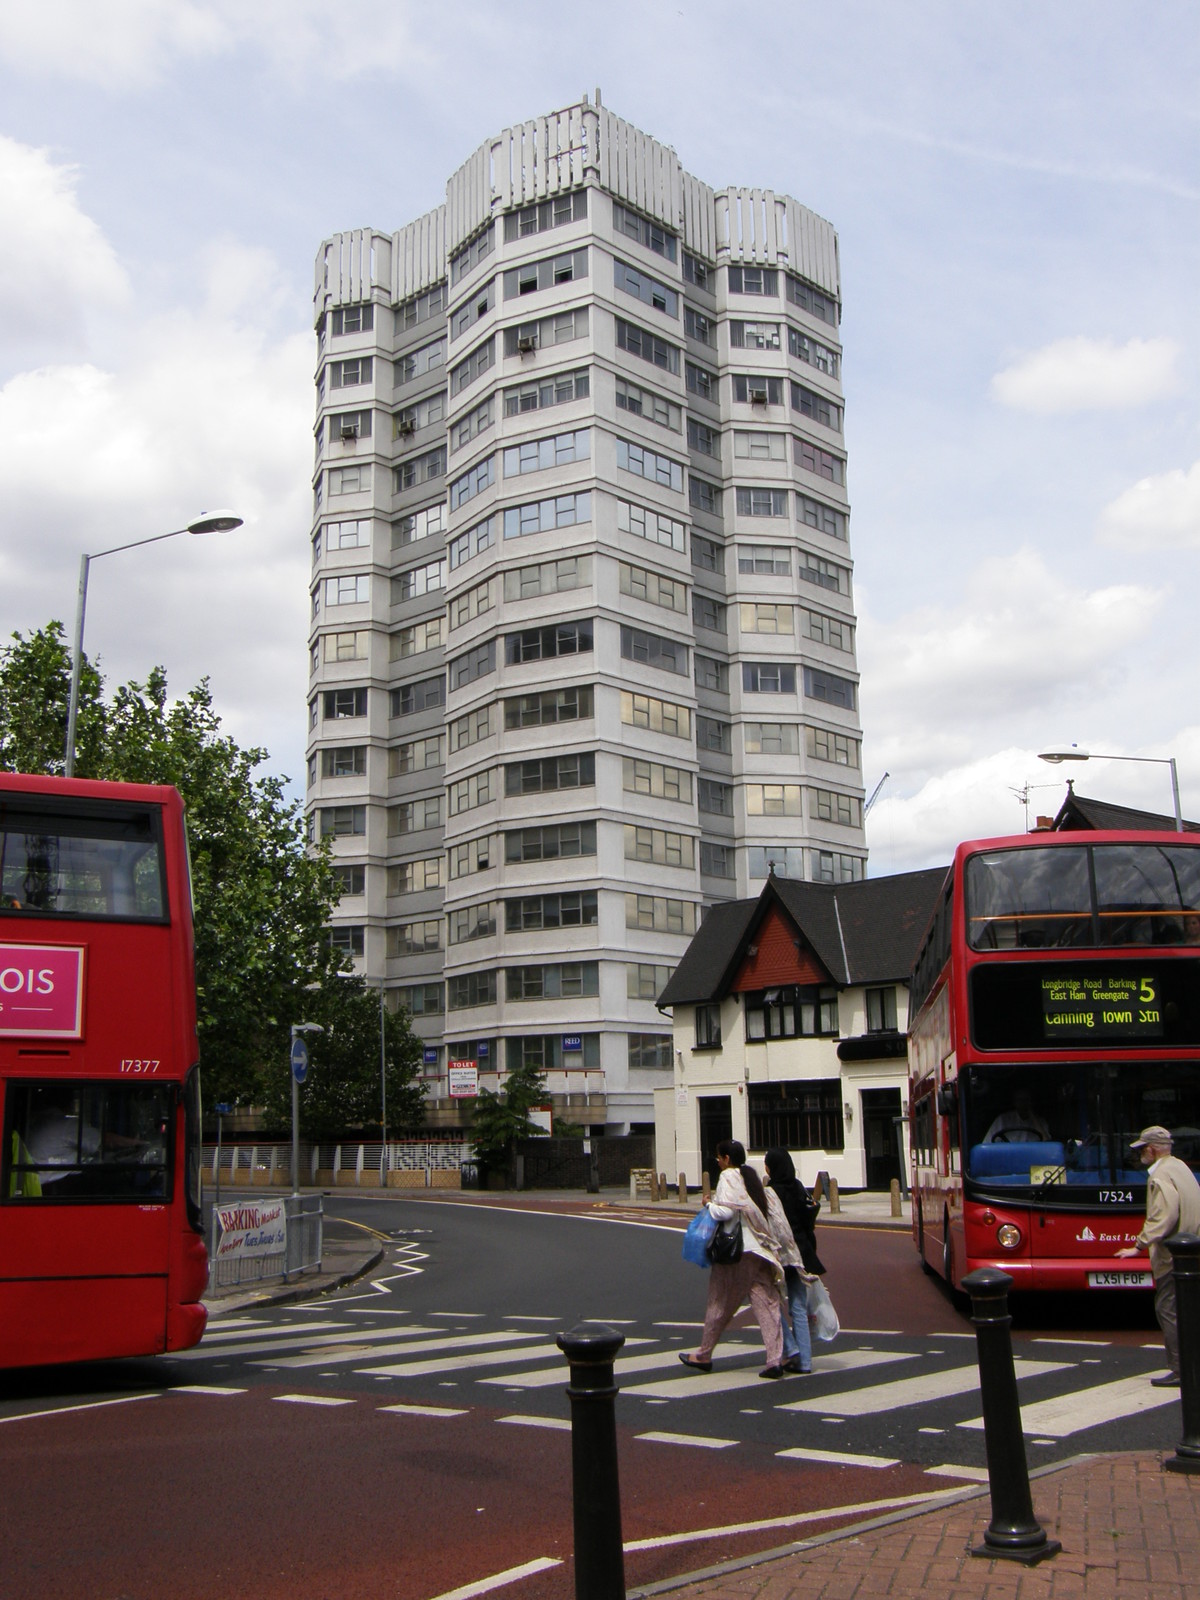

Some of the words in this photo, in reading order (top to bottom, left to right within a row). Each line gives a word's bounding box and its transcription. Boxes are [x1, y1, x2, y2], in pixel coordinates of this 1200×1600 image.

[1041, 979, 1081, 991] Longbridge
[1083, 979, 1103, 989] Road
[1108, 979, 1137, 991] Barking
[1139, 978, 1155, 1003] 5
[1050, 991, 1067, 1000] East
[1069, 991, 1087, 1000] Ham
[1092, 990, 1130, 1002] Greengate
[1045, 1011, 1095, 1028] Canning
[564, 1036, 580, 1045] REED
[120, 1059, 161, 1073] 17377
[1099, 1191, 1133, 1203] 17524
[221, 1209, 260, 1232] BARKING
[1099, 1233, 1121, 1241] East
[1095, 1273, 1121, 1285] LX51
[1123, 1273, 1146, 1284] FOF
